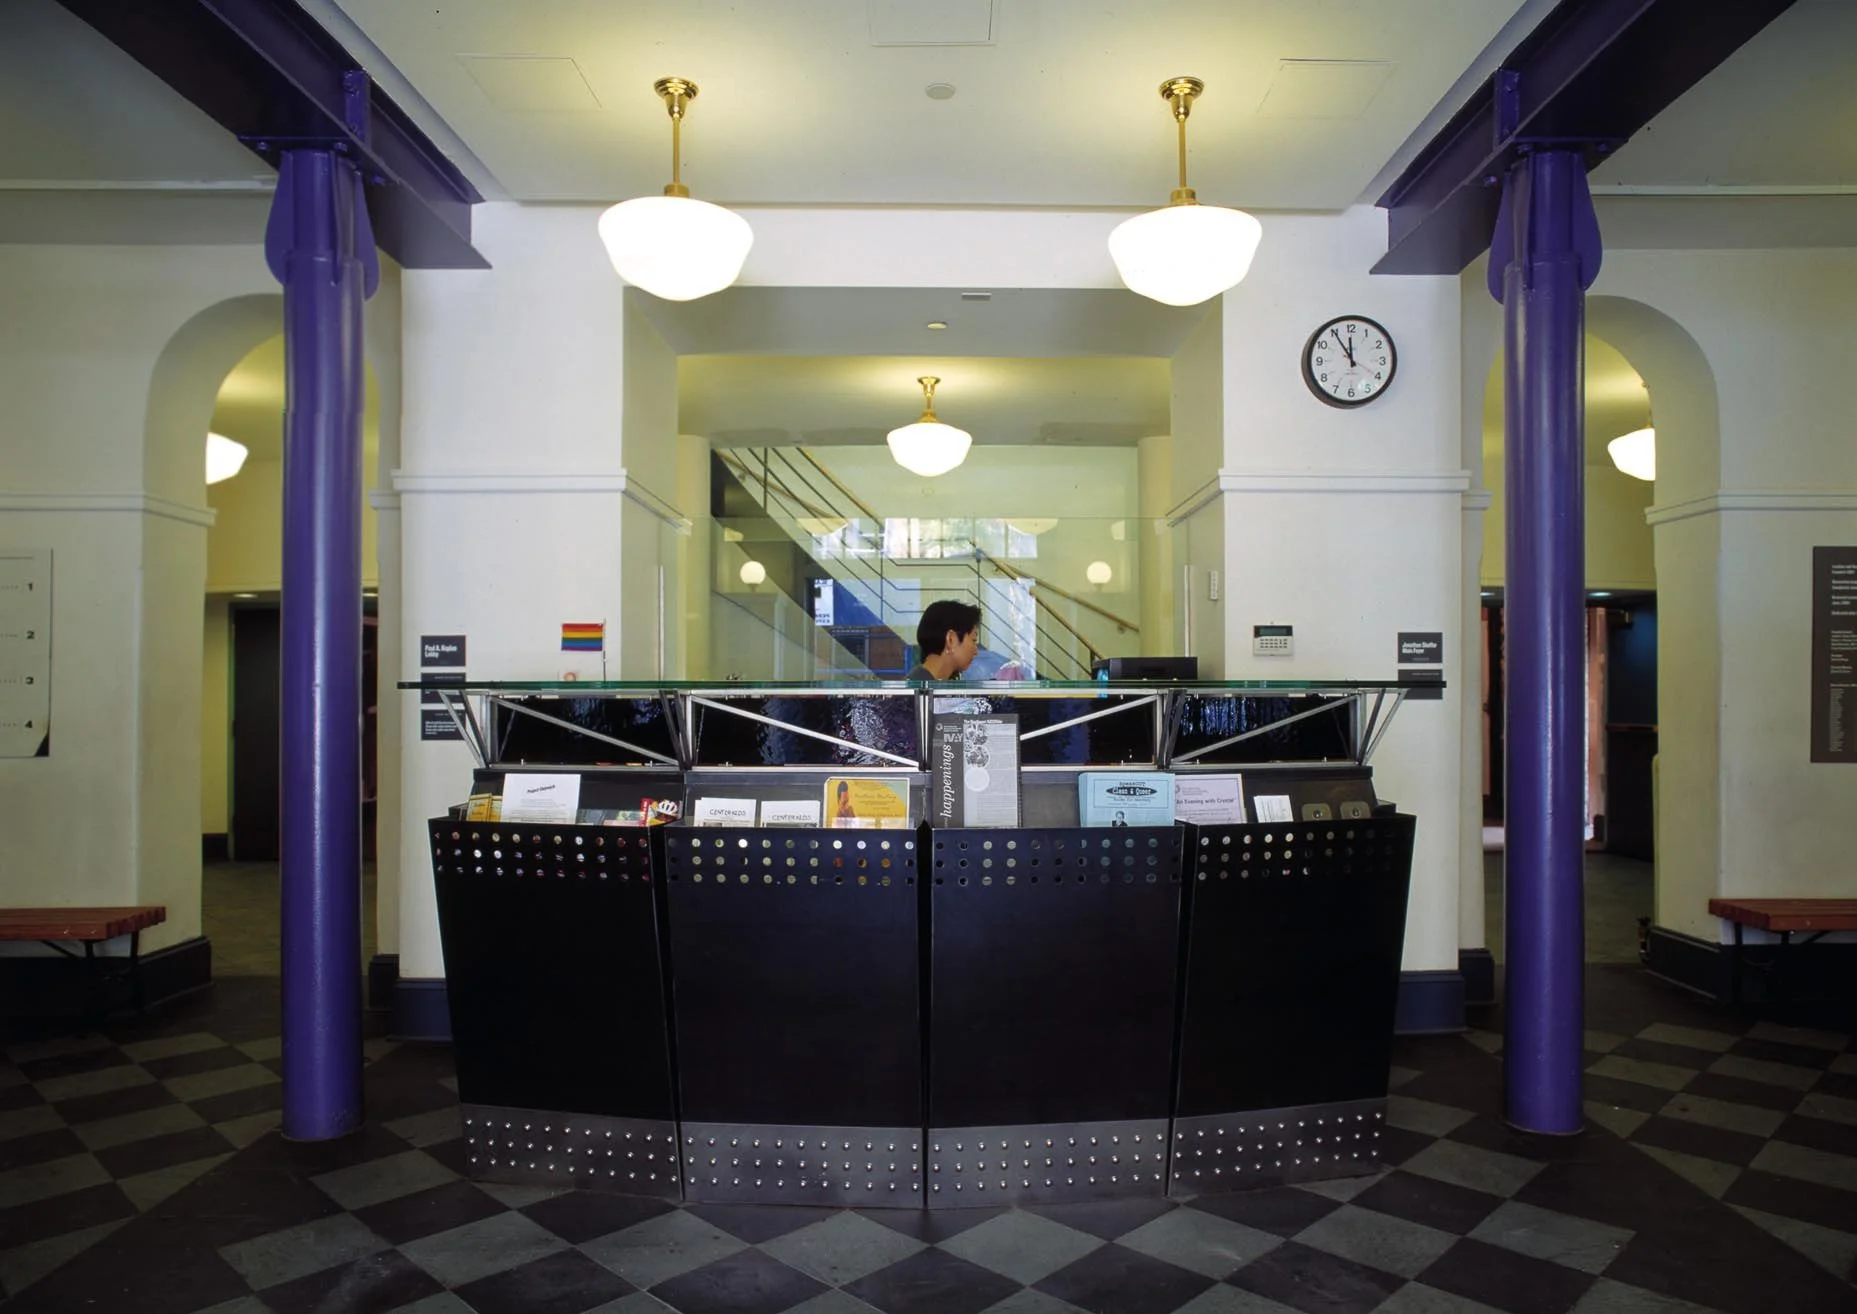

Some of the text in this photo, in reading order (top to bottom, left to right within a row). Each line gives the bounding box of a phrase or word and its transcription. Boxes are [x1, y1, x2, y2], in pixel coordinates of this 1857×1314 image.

[1346, 323, 1356, 333] 12
[1317, 340, 1328, 349] 10
[1375, 340, 1383, 349] 2
[1316, 357, 1323, 366] 9
[1379, 357, 1386, 366] 3
[1320, 373, 1328, 382] 8
[1374, 371, 1381, 380] 4
[1332, 385, 1339, 394] 7
[1348, 388, 1355, 397] 6
[1365, 384, 1372, 393] 5
[27, 583, 33, 591] 1
[26, 631, 35, 639] 2
[25, 676, 34, 685] 3
[24, 720, 33, 729] 4
[940, 744, 955, 817] happenings
